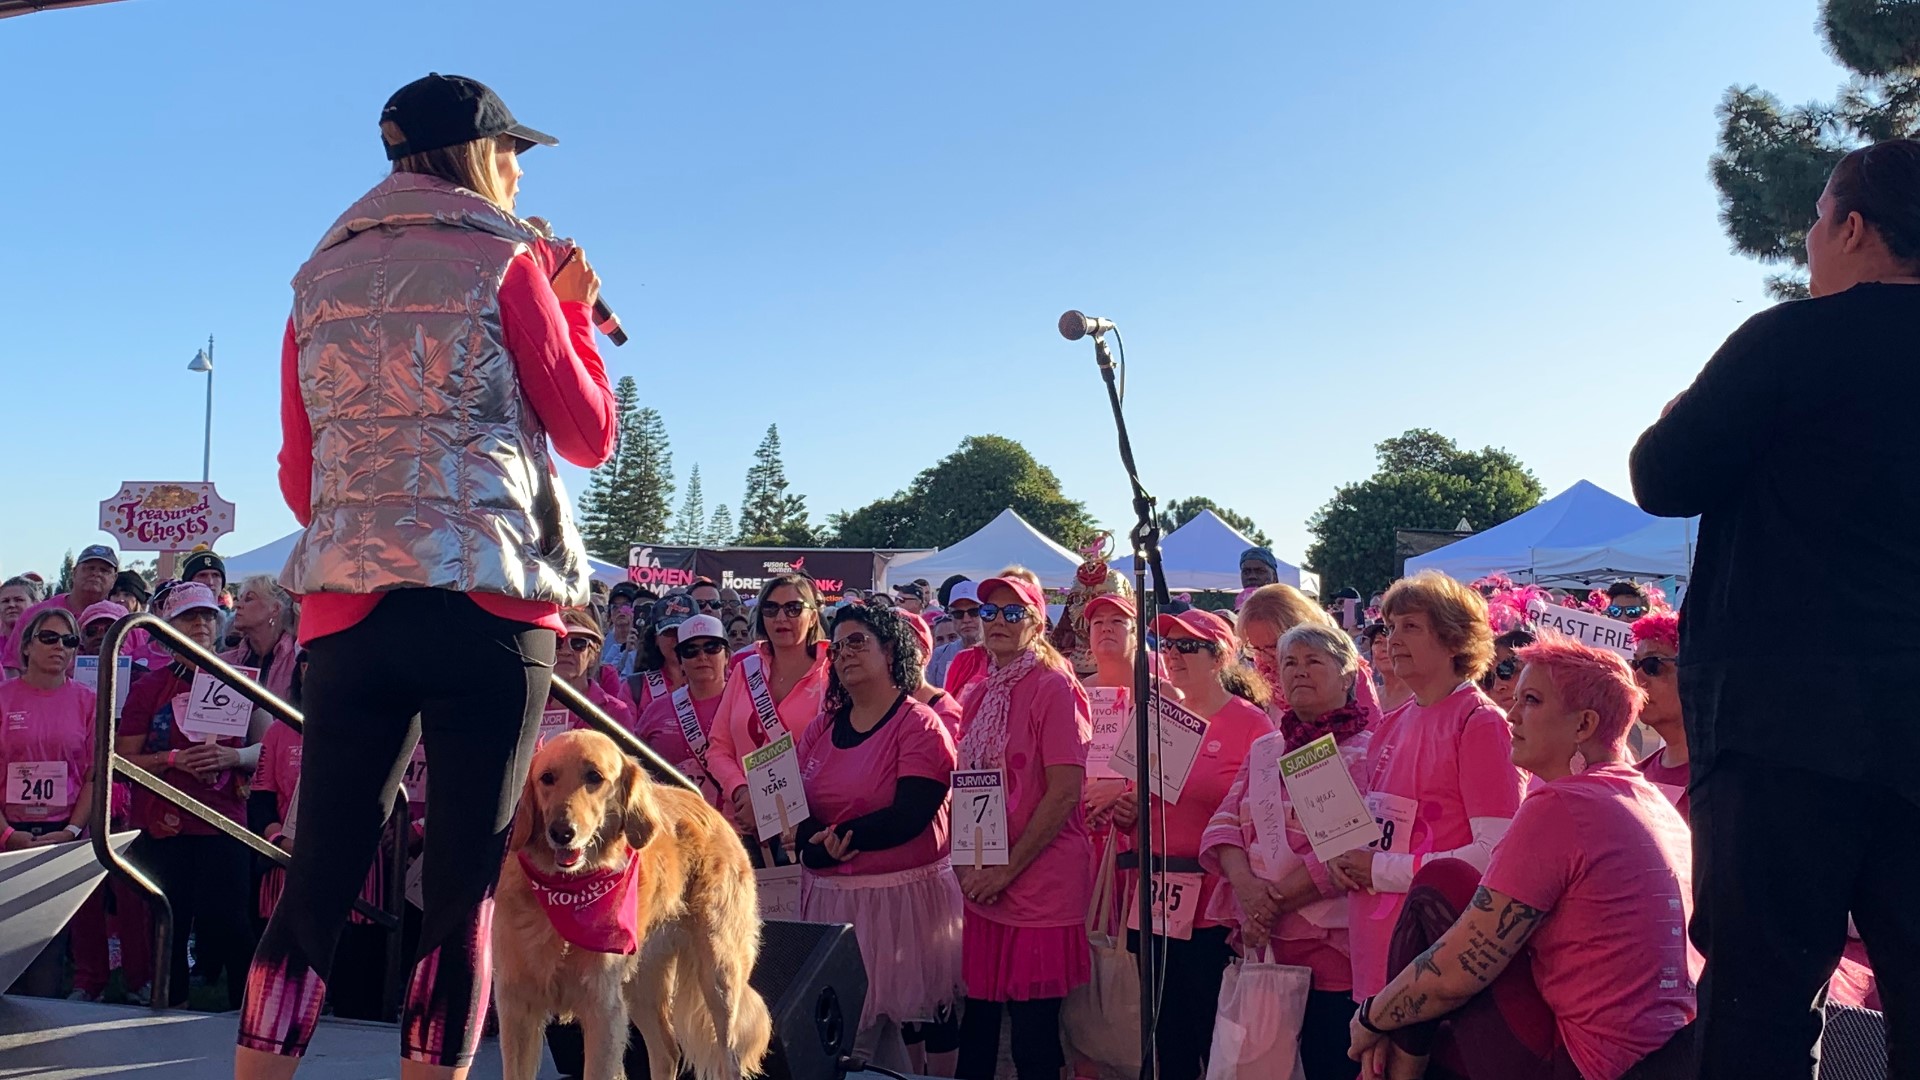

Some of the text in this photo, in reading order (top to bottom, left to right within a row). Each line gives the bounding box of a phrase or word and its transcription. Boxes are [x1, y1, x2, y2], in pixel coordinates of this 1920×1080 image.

[117, 495, 210, 533] Treasured
[138, 515, 208, 543] Chests
[629, 566, 693, 585] KOMEN
[722, 570, 734, 578] BE
[722, 578, 762, 589] MORE
[1530, 609, 1634, 651] REAST FRIE
[200, 681, 230, 707] 16
[755, 690, 778, 730] YOUNG
[1148, 695, 1201, 732] SURVIVOR
[680, 710, 703, 742] YOUNG
[1092, 718, 1118, 734] YEARS
[749, 739, 789, 768] SURVIVOR
[1285, 743, 1332, 773] SURVIVOR
[761, 777, 788, 797] YEARS
[767, 768, 777, 782] 5
[957, 774, 998, 787] SURVIVOR
[21, 779, 54, 800] 240
[973, 794, 990, 823] 7
